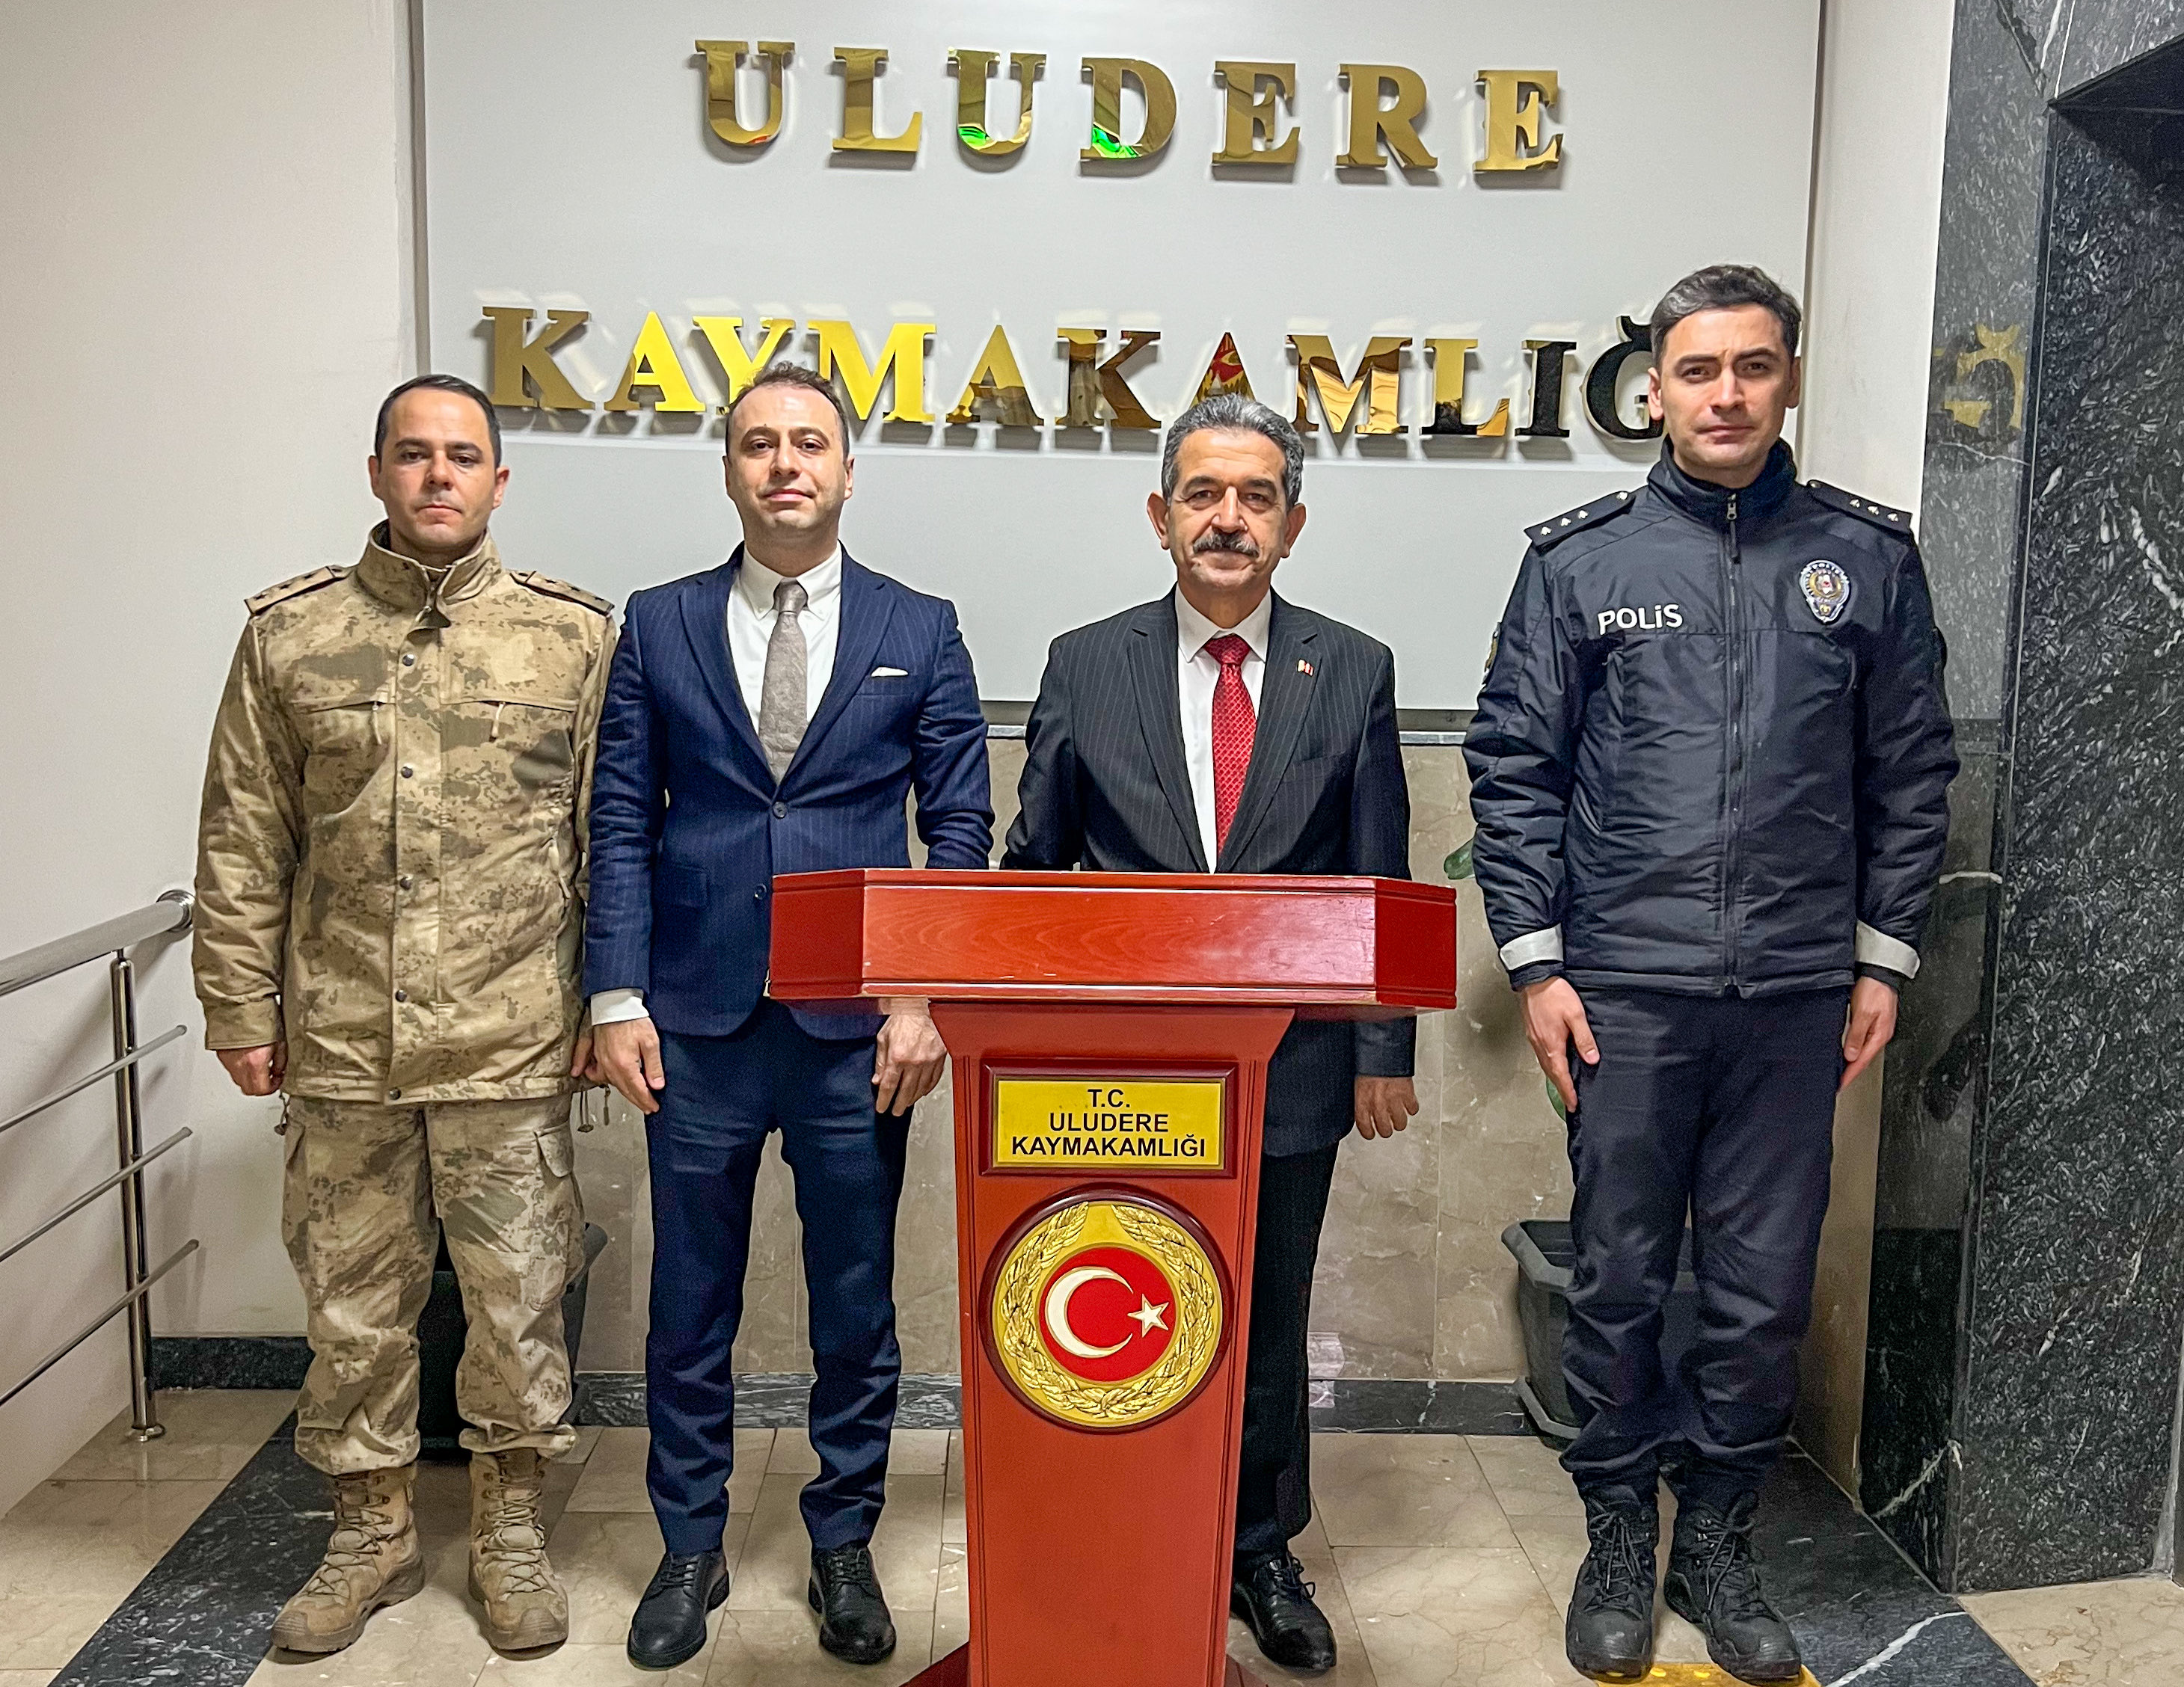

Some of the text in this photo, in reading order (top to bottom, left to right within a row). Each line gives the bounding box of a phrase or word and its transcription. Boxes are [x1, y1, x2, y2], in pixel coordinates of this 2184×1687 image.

[694, 39, 1562, 170] ULUDERE
[482, 307, 1665, 440] KAYMAKAMLIĞ
[1087, 1089, 1131, 1107] T.C.
[1049, 1113, 1169, 1132] ULUDERE
[1011, 1134, 1206, 1158] KAYMAKAMLIĞI
